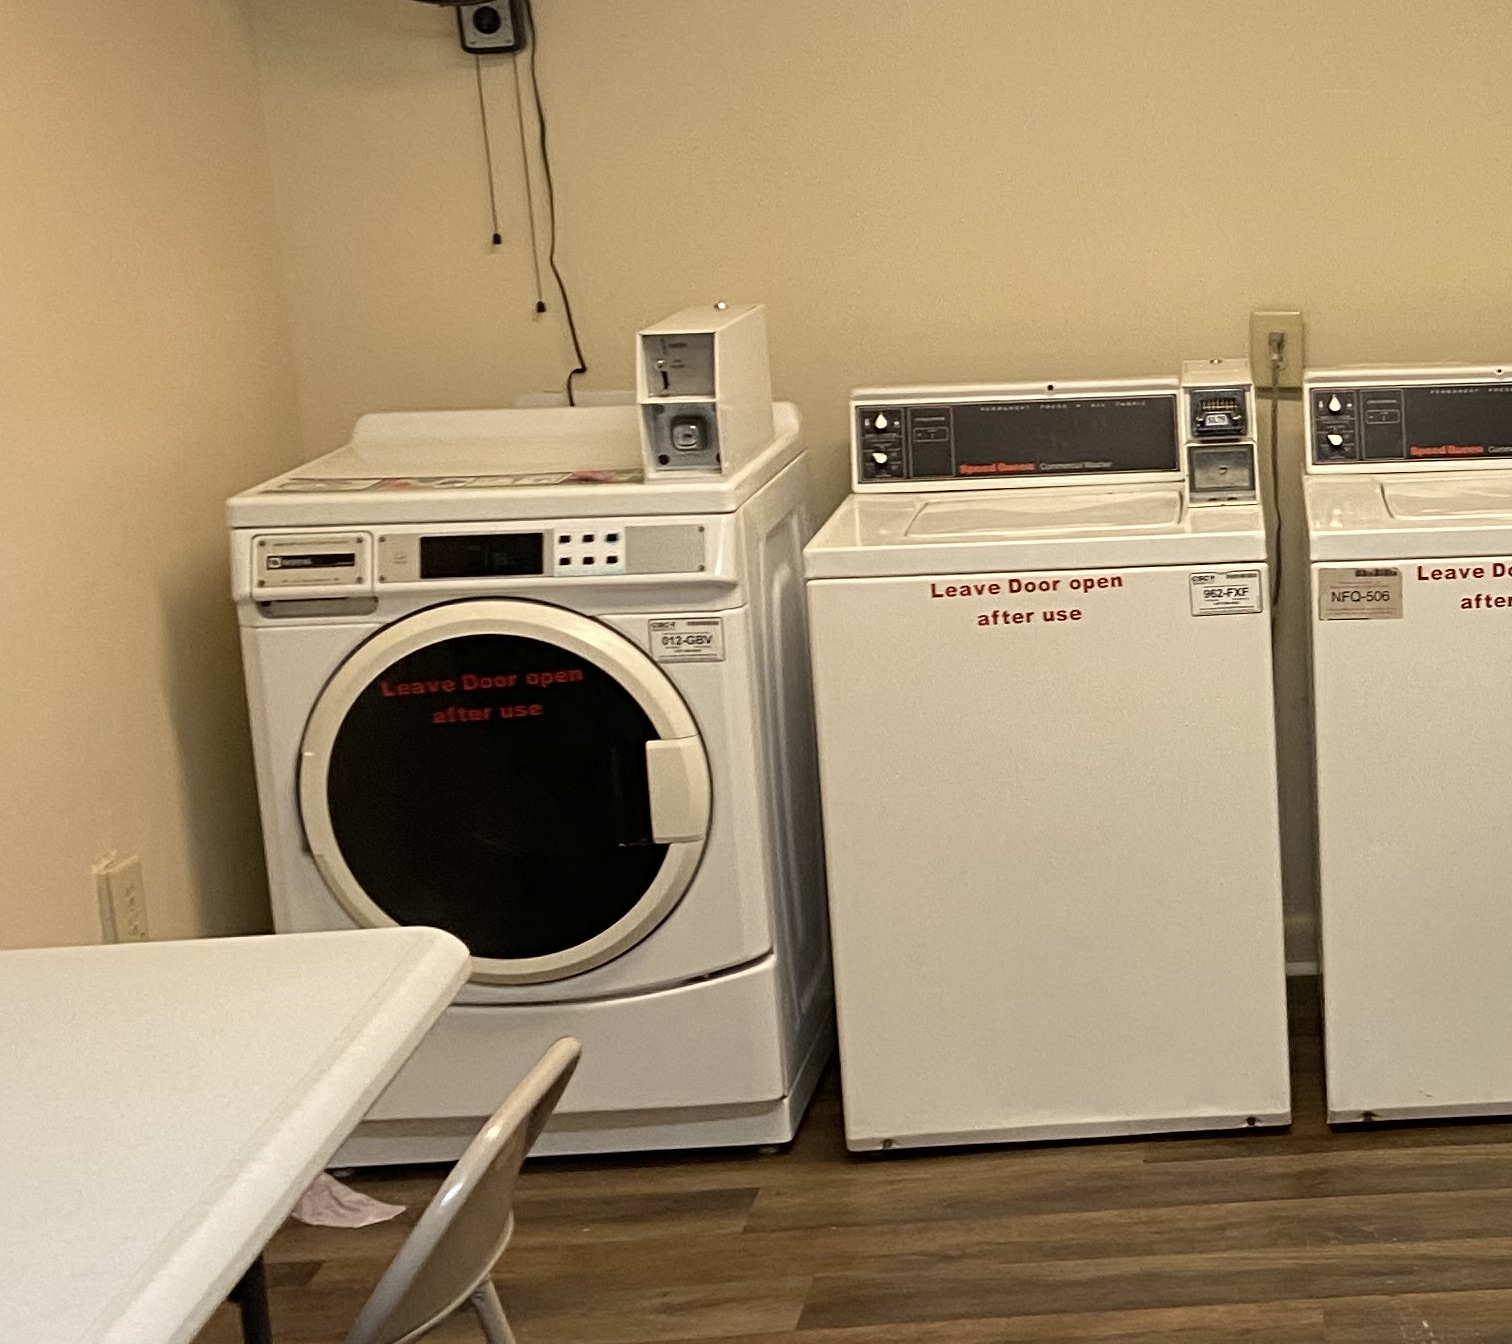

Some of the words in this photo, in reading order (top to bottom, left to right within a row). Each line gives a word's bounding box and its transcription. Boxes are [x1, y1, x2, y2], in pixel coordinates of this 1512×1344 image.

[1417, 565, 1485, 581] Leave
[930, 582, 1001, 599] Leave
[1008, 578, 1061, 594] Door
[1069, 575, 1124, 594] open
[977, 609, 1035, 626] after
[1042, 608, 1083, 622] use
[380, 679, 456, 698] Leave
[461, 672, 518, 691] Door
[525, 669, 584, 688] open
[432, 706, 492, 724] after
[499, 703, 544, 719] use
